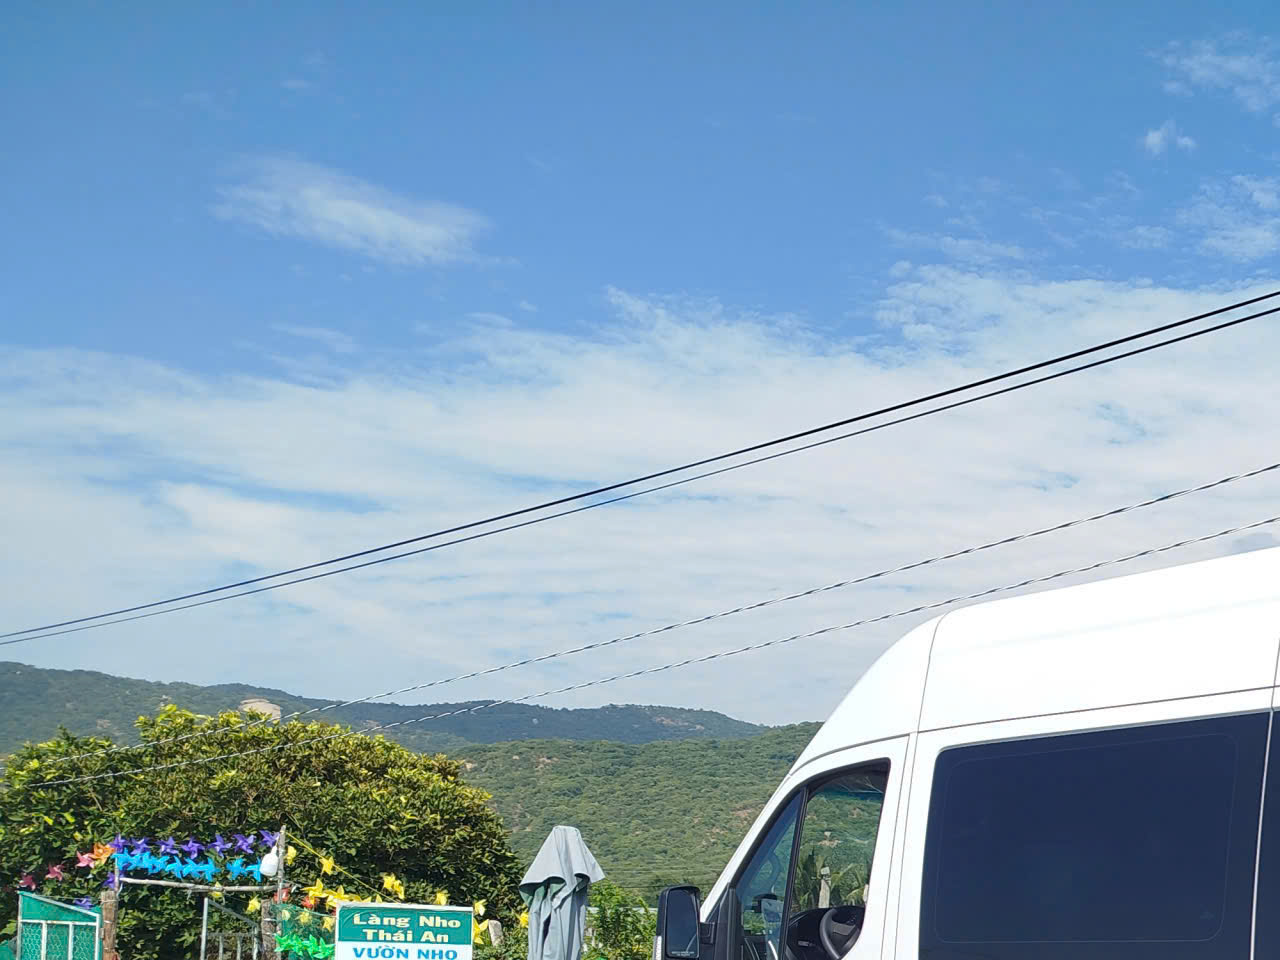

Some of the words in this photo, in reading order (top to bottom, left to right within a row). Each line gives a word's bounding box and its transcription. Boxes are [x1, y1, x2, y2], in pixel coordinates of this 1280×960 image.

[353, 912, 411, 928] Làng
[419, 915, 462, 928] Nho
[362, 928, 414, 942] Thái
[420, 930, 450, 943] An
[352, 945, 409, 959] VƯỜN
[417, 948, 459, 960] NHO
